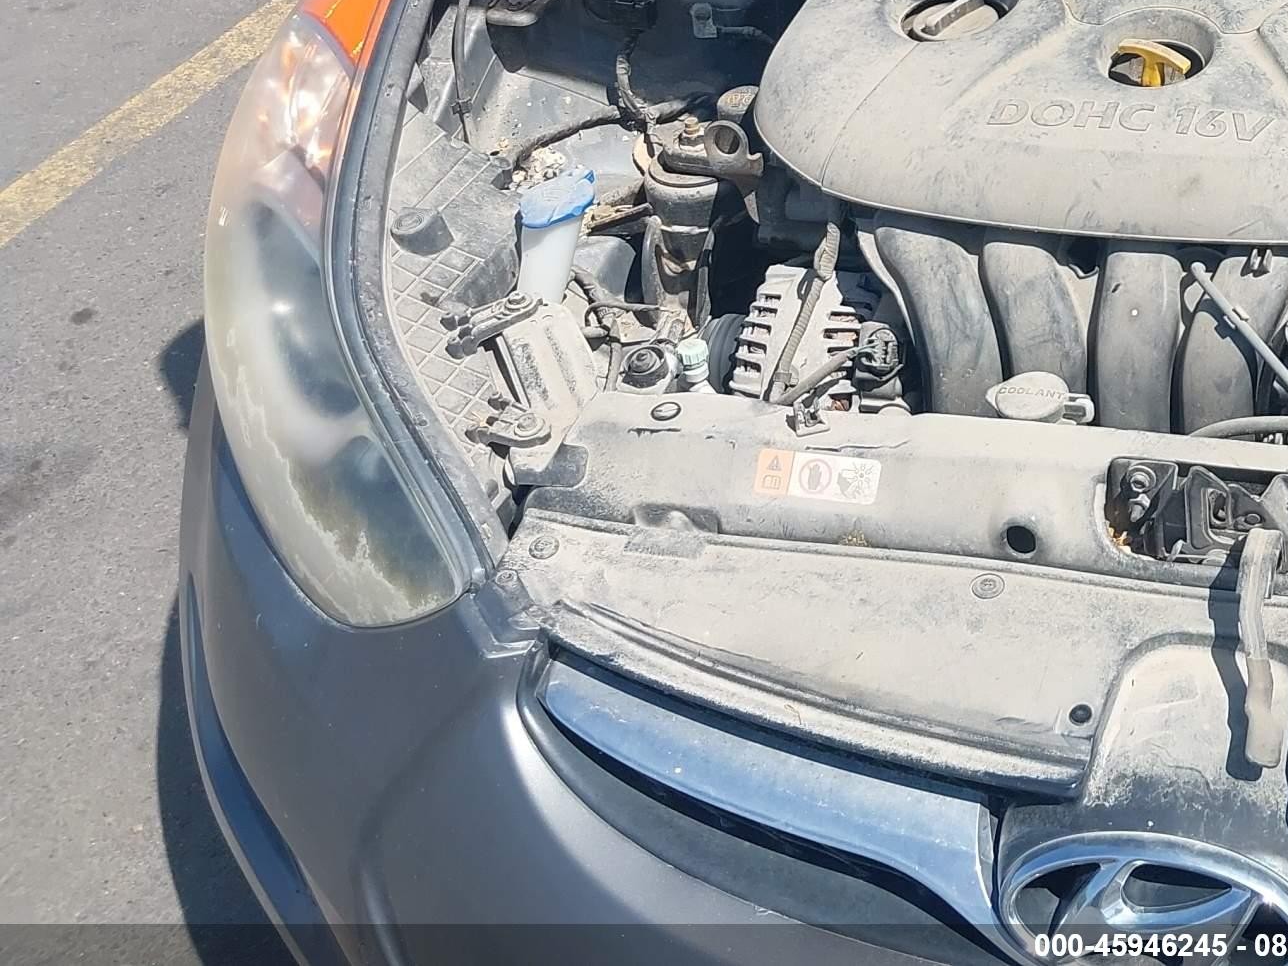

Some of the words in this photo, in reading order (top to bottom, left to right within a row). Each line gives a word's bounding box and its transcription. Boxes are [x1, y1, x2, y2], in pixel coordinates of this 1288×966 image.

[986, 99, 1155, 131] DOHC
[1175, 105, 1274, 141] 16V
[998, 386, 1066, 400] COOLANT
